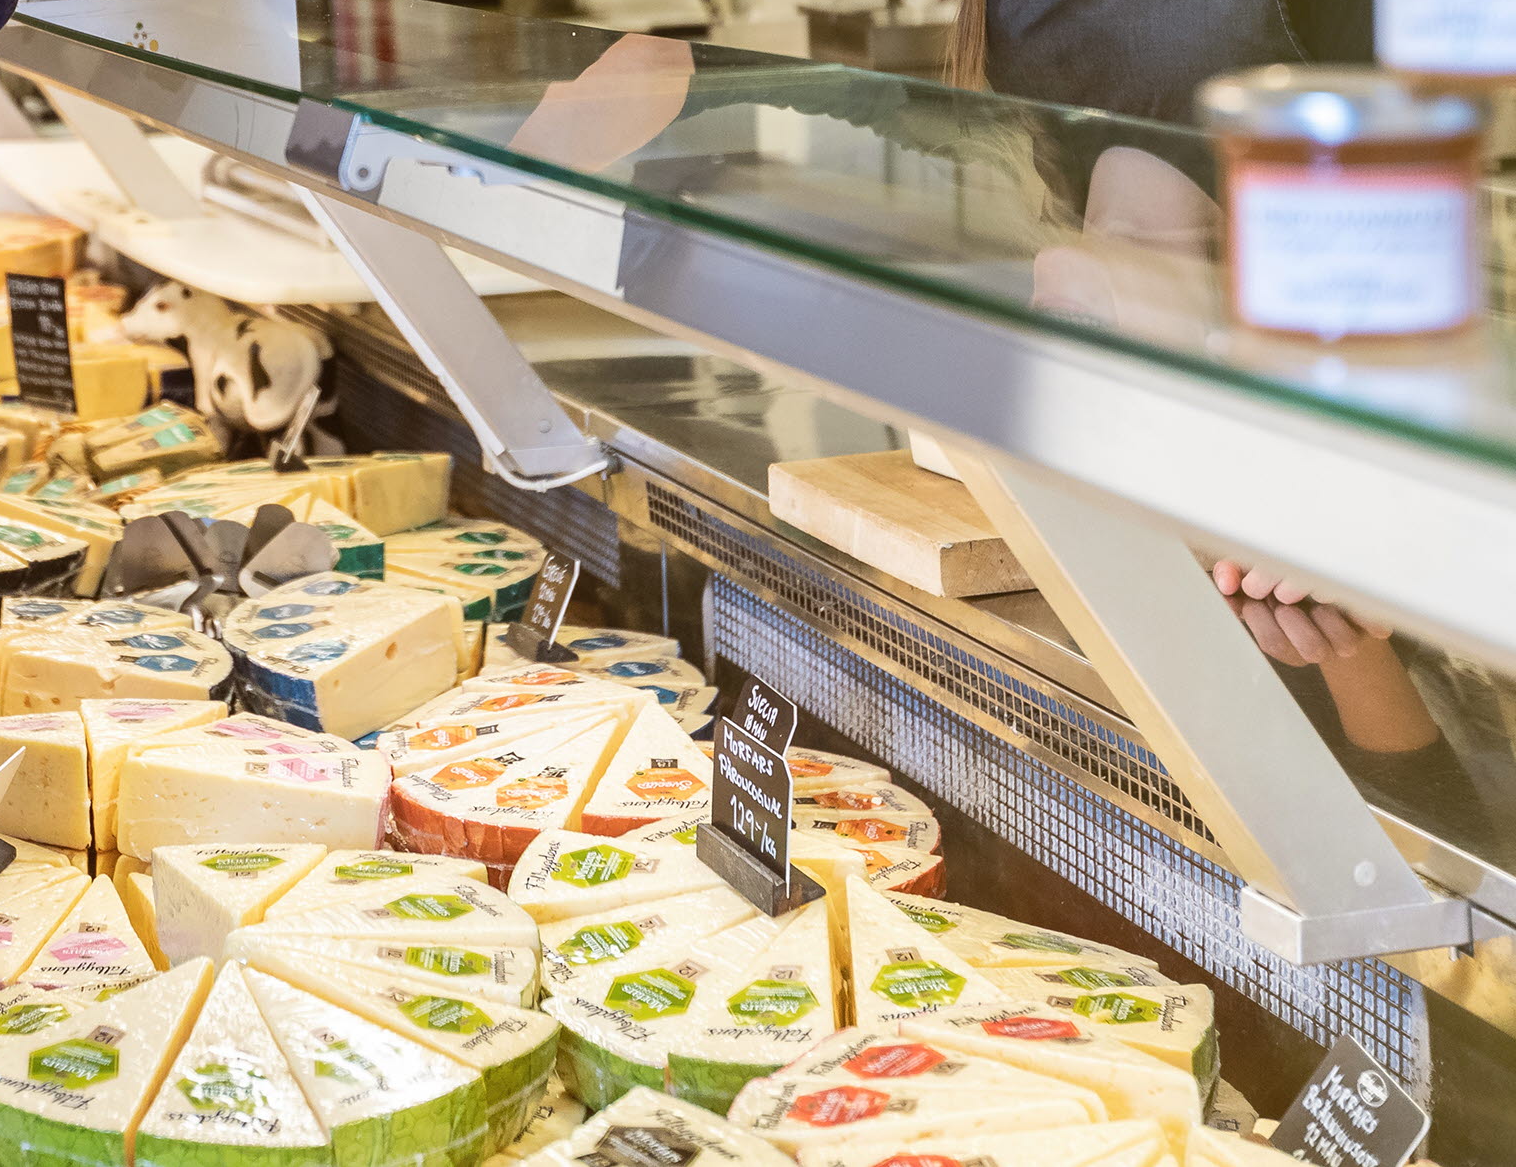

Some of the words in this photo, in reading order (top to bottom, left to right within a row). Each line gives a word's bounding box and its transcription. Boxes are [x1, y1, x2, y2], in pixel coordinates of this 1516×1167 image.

[747, 684, 779, 728] SVECIA
[723, 724, 774, 777] MORFARS
[637, 779, 693, 791] Svecia
[621, 797, 709, 810] Falbygdens
[897, 952, 915, 961] 12
[40, 961, 132, 976] Falbygdens
[679, 966, 698, 979] 12
[775, 970, 793, 980] 12
[888, 979, 951, 995] Morfars
[621, 983, 670, 1013] Morfars
[739, 1001, 800, 1015] Morfars
[93, 1031, 114, 1045] 12
[706, 1023, 813, 1043] Falbygdens
[40, 1056, 99, 1081] Morfars
[1321, 1065, 1379, 1134] MORFARS
